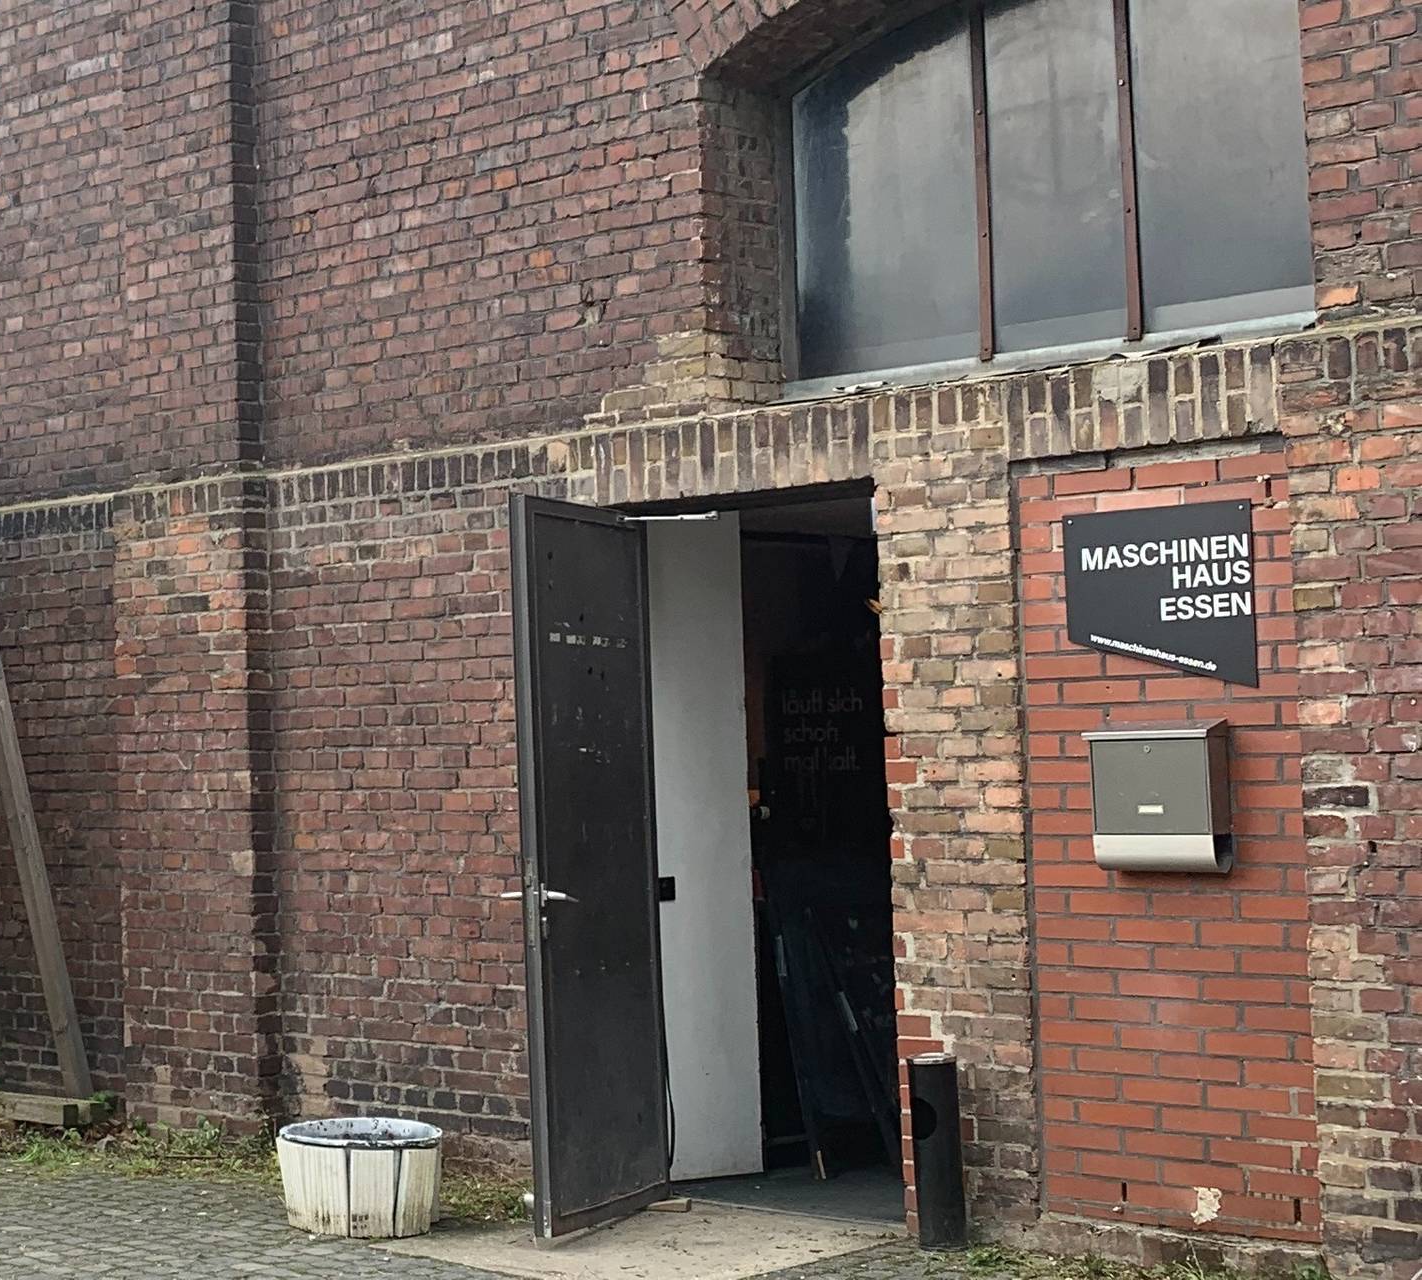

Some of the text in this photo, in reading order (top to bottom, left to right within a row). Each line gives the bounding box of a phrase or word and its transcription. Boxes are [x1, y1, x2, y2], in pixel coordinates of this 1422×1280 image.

[1081, 533, 1249, 572] MASCHINEN
[1172, 560, 1252, 590] HAUS
[1160, 591, 1252, 622] ESSEN
[1090, 633, 1218, 672] www.maschinenhaus-essen.de
